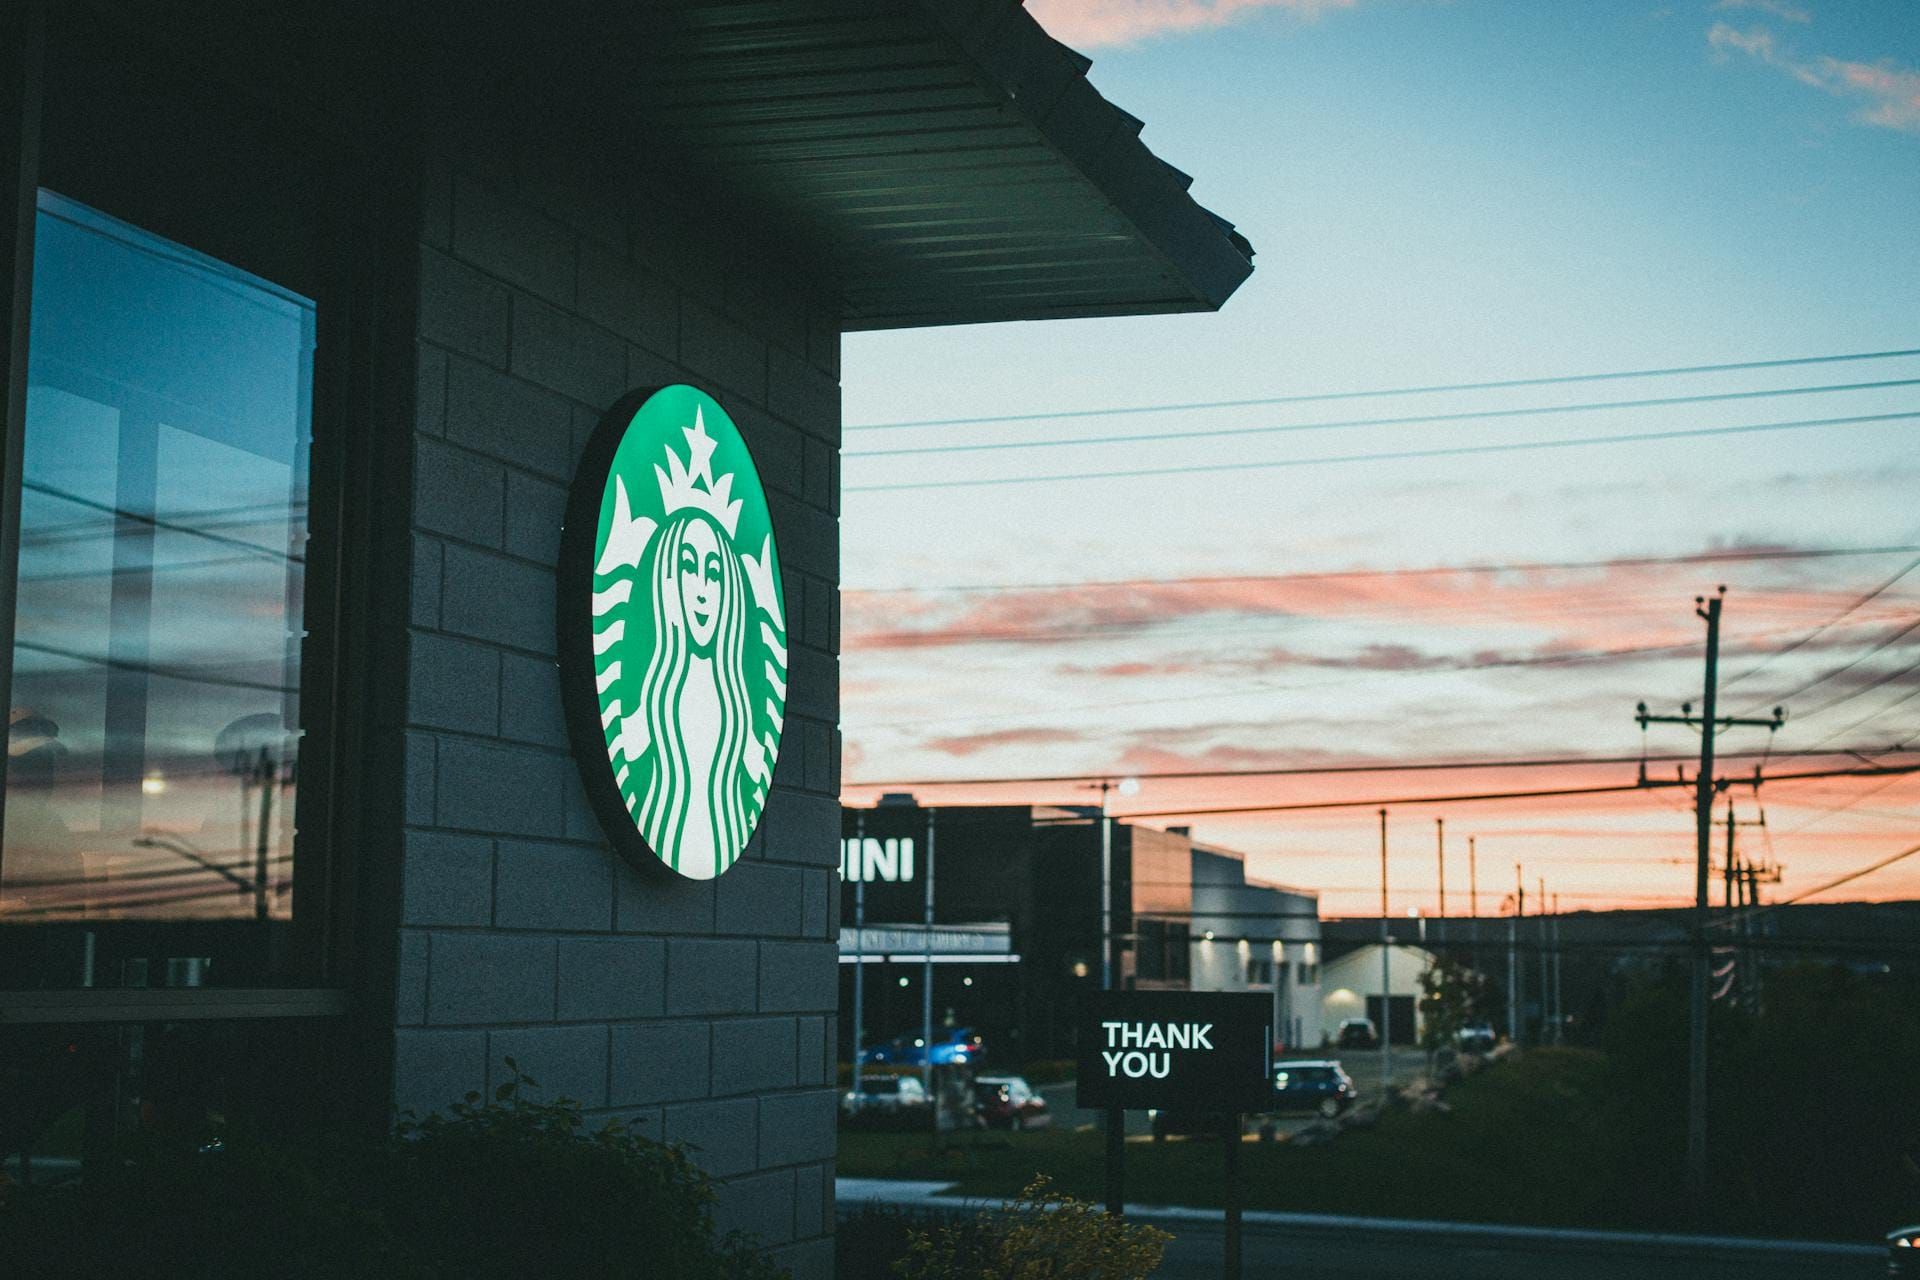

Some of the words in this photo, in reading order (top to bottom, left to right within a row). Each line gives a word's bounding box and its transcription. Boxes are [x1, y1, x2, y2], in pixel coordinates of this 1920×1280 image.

[841, 838, 914, 882] INI
[1102, 1022, 1214, 1050] THANK
[1102, 1052, 1170, 1079] YOU
